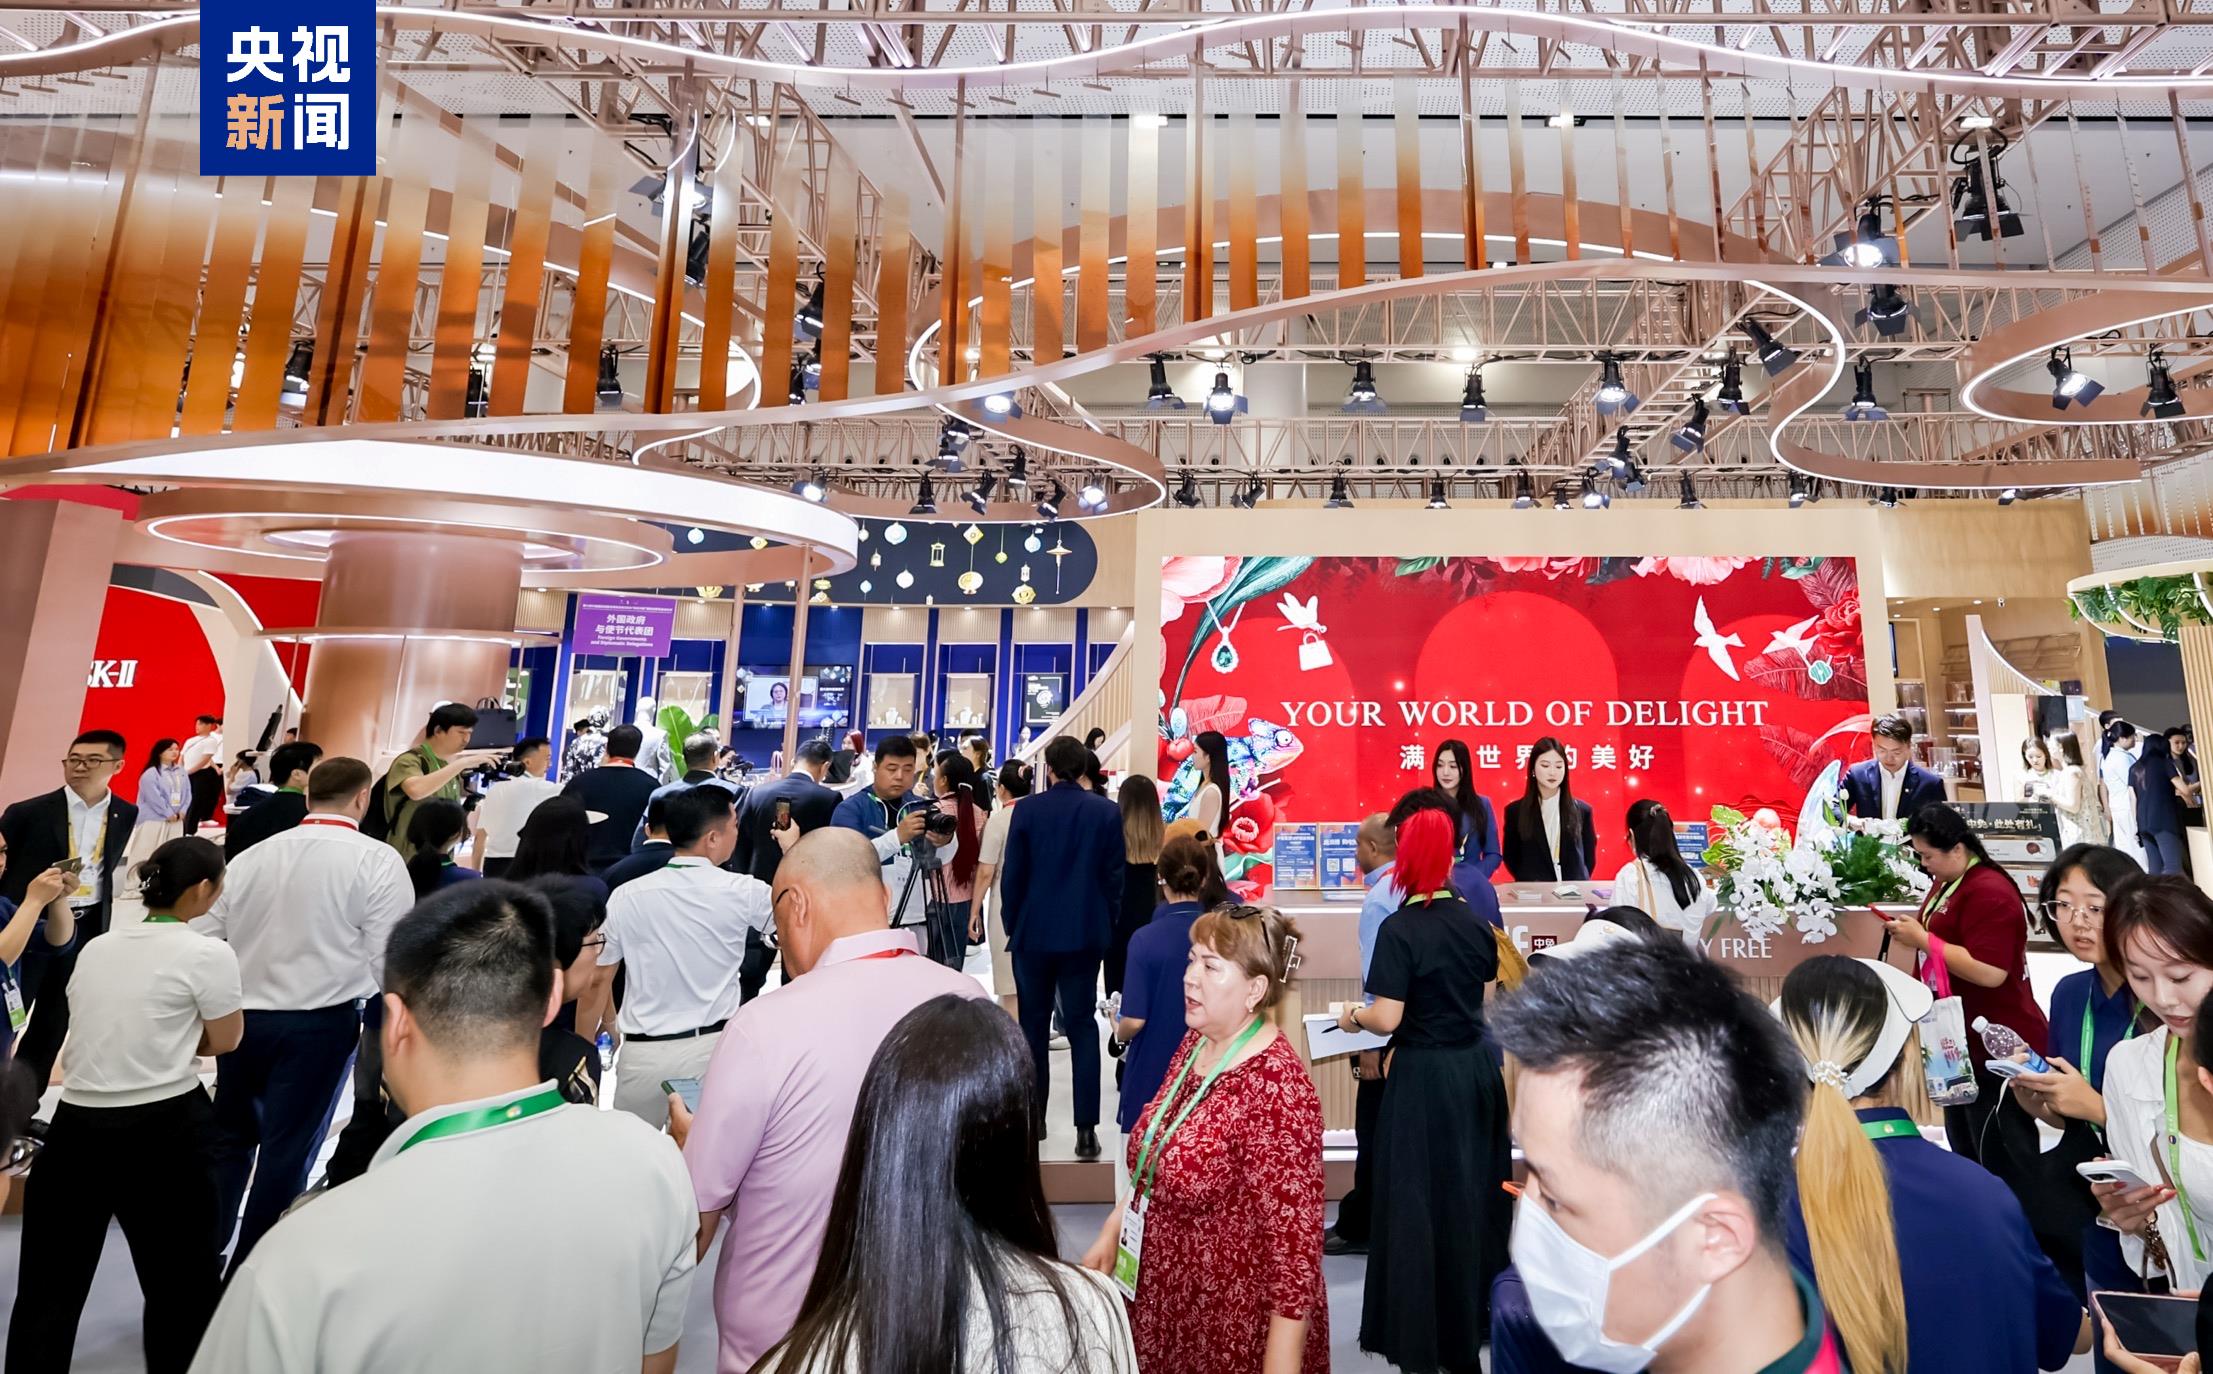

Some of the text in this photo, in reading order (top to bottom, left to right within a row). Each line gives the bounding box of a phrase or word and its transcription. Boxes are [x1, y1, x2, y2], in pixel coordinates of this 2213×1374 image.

[606, 614, 646, 625] 外国政府
[1280, 700, 1768, 727] YOUR WORLD OF DELIGHT
[1721, 938, 1772, 958] FREE
